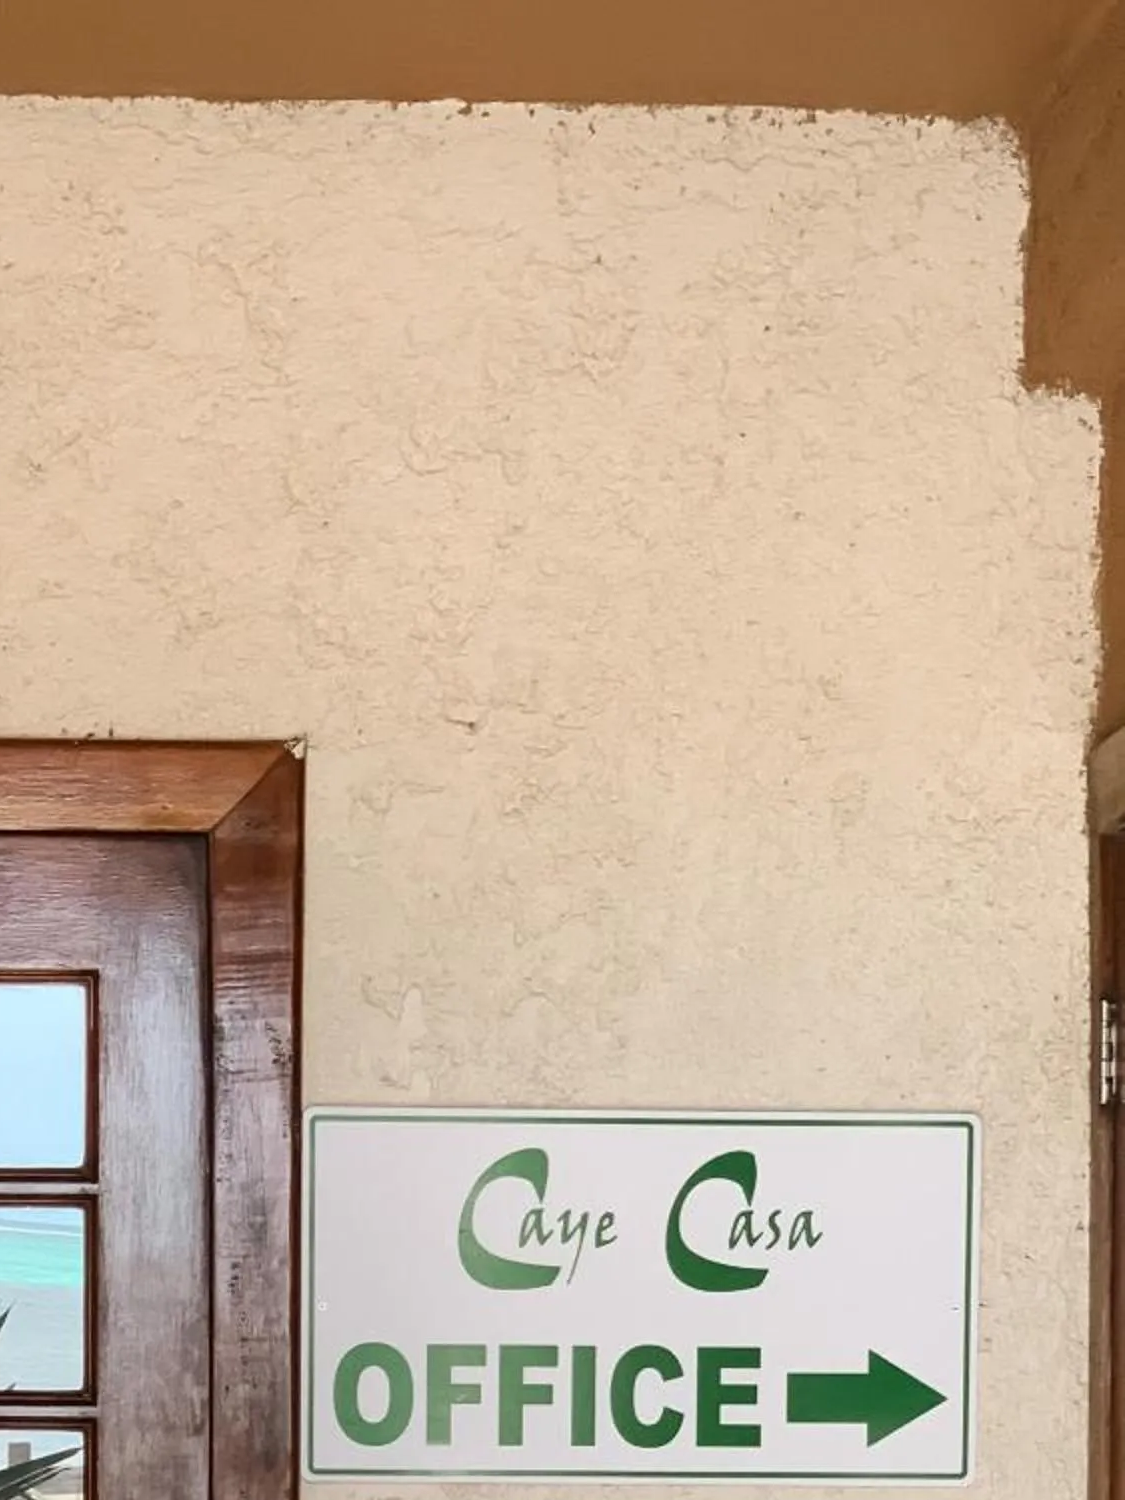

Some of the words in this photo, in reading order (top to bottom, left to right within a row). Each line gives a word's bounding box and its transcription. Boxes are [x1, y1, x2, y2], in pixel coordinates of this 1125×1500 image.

[458, 1147, 618, 1291] Caye
[665, 1150, 823, 1293] Casa
[333, 1342, 762, 1449] OFFICE
